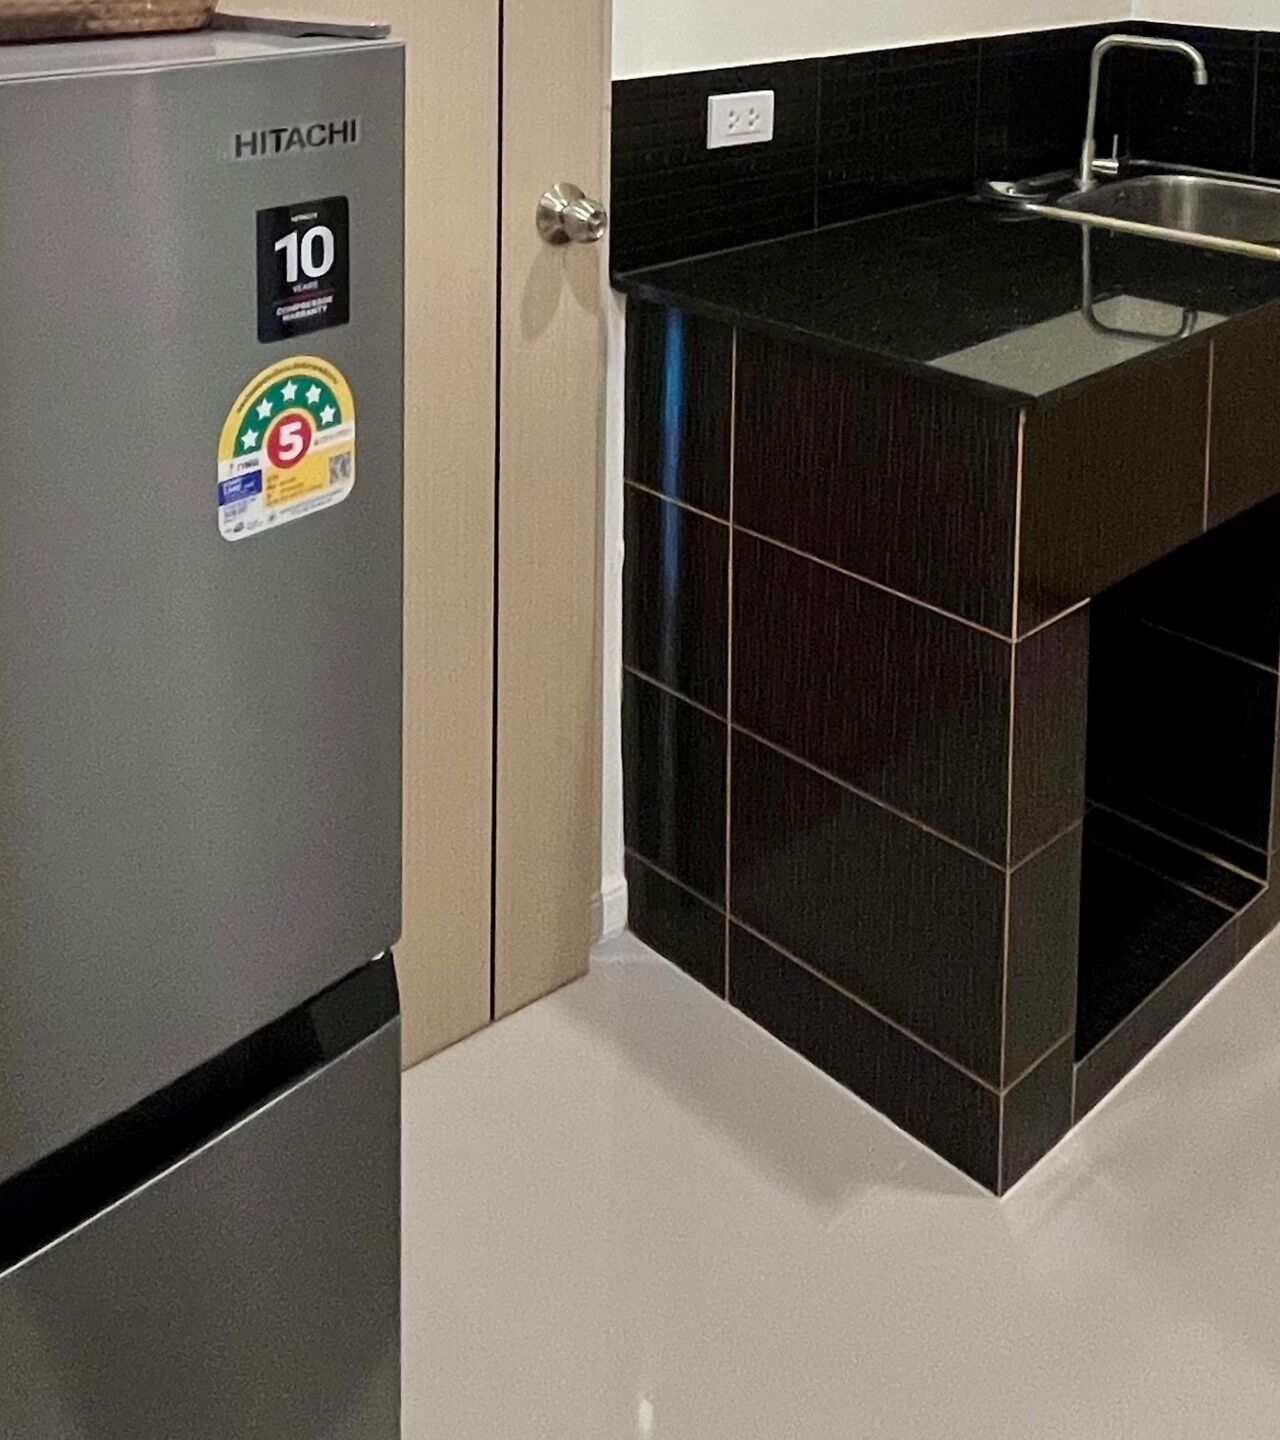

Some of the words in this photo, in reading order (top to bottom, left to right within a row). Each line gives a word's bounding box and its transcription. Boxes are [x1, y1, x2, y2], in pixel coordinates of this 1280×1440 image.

[235, 119, 357, 158] HITACHI
[274, 225, 334, 283] 10
[276, 295, 334, 316] COMPRESSOR
[282, 304, 328, 321] WARRANTY
[278, 421, 304, 461] 5
